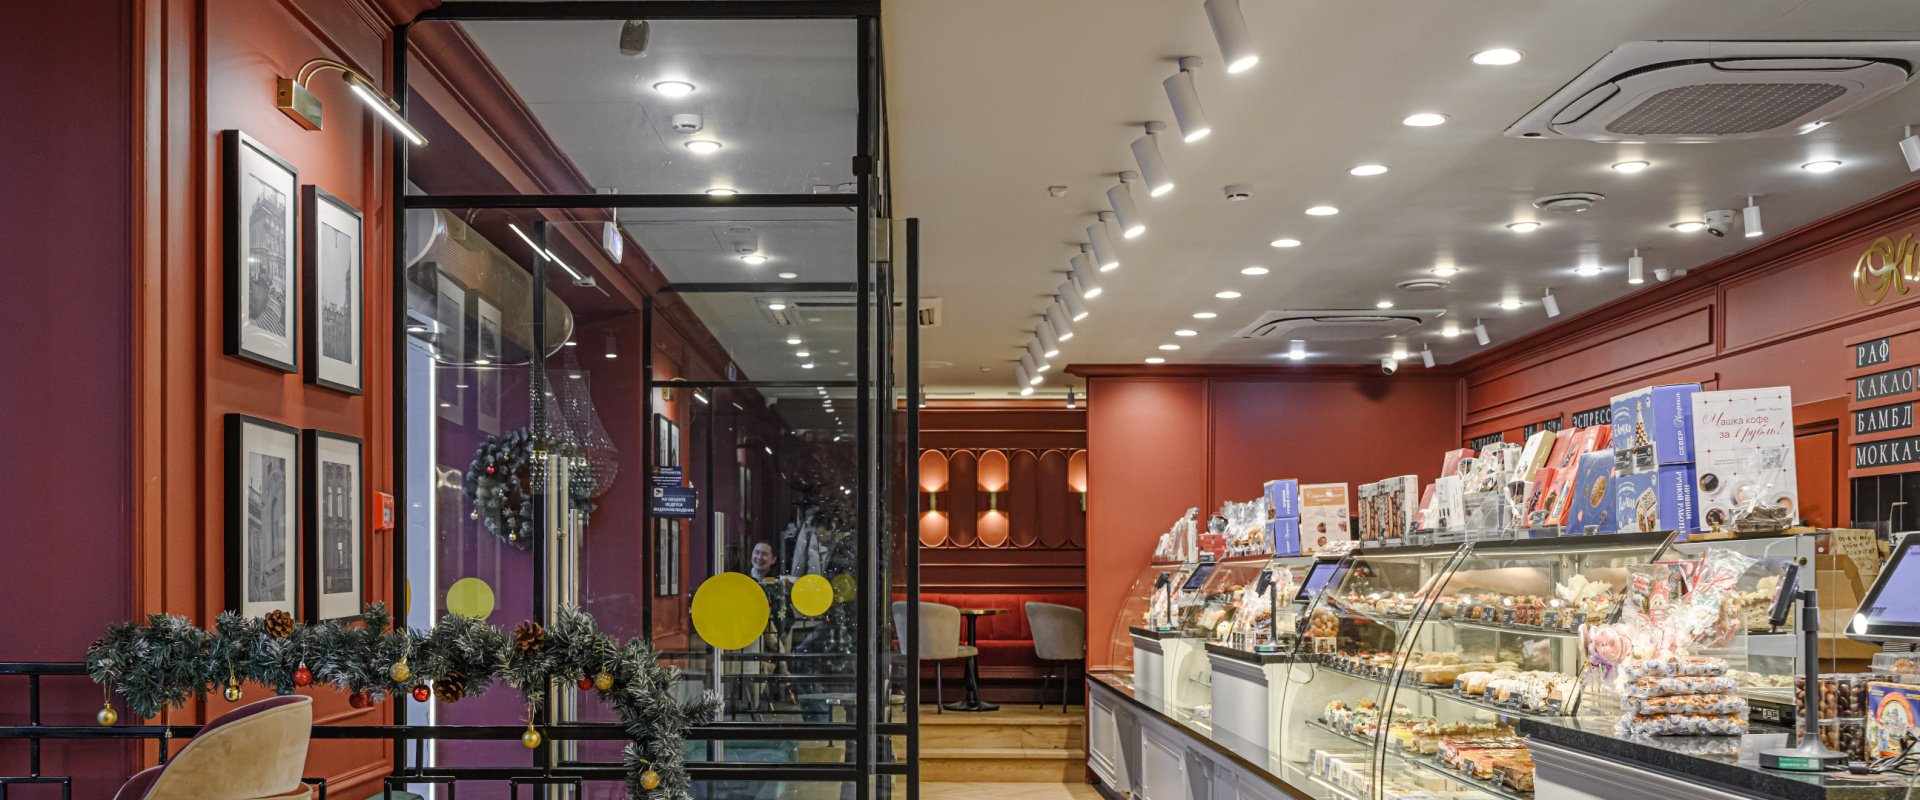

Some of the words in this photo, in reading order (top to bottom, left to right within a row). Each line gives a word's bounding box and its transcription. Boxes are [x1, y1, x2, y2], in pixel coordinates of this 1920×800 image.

[1858, 340, 1889, 365] РАФ
[1857, 370, 1912, 399] КАКАО
[1702, 411, 1744, 427] Чашка
[1746, 415, 1769, 424] кофе
[1858, 405, 1911, 432] БАМБЛ
[1719, 431, 1730, 439] за
